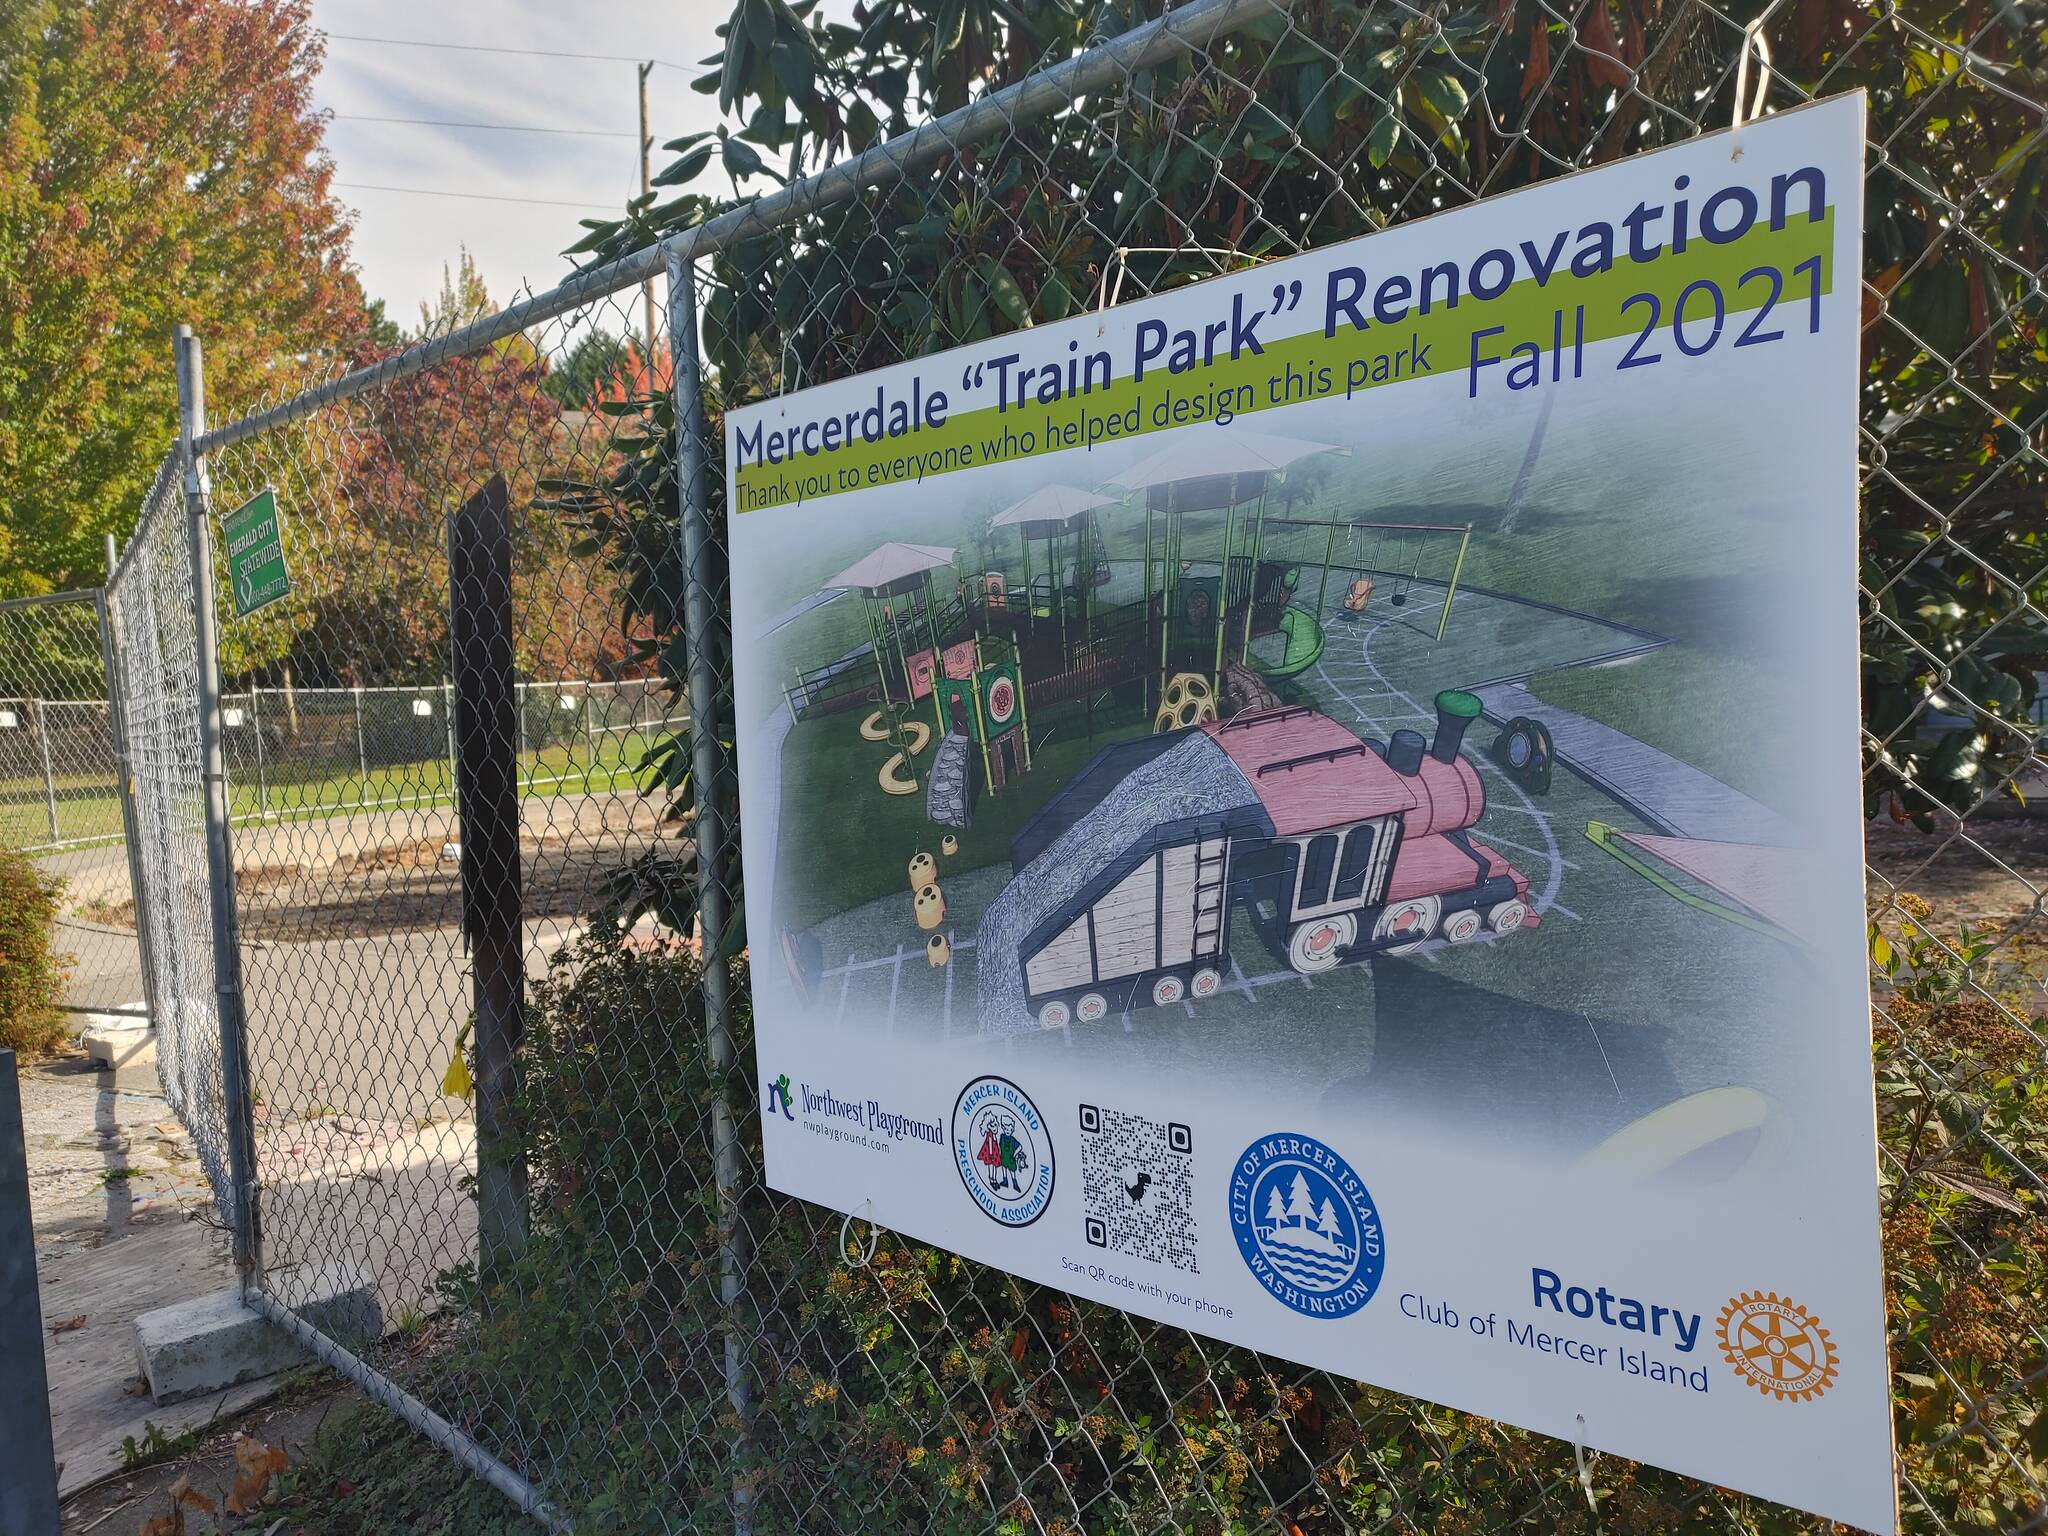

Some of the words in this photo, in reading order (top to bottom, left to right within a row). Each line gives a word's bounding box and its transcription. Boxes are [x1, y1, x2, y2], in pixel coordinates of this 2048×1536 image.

[736, 376, 948, 472] Mercerdale
[1325, 166, 1828, 338] Renovation
[1469, 305, 1584, 399] Fall
[1616, 255, 1824, 372] 2021
[736, 472, 790, 512] Thank
[795, 473, 834, 507] you
[838, 465, 860, 489] to
[868, 443, 973, 485] everyone
[979, 425, 1036, 461] who
[1045, 396, 1141, 452] helped
[1151, 373, 1255, 427] design
[1269, 358, 1332, 404] this
[1346, 333, 1432, 401] park
[230, 528, 258, 559] EMERALD
[258, 517, 274, 539] CITY
[240, 540, 280, 579] STATEWIDE
[800, 1083, 865, 1127] Northwest
[867, 1100, 945, 1146] Playground
[803, 1120, 890, 1153] nwplayground.com
[963, 1085, 1000, 1116] MERCER
[1003, 1087, 1039, 1131] ISLAND
[958, 1139, 998, 1216] PRESCHOOL
[1001, 1164, 1050, 1221] ASSOCIATION
[1234, 1175, 1249, 1225] CITY
[1243, 1151, 1261, 1176] OF
[1261, 1139, 1337, 1173] MERCER
[1338, 1169, 1380, 1257] ISLAND
[1061, 1256, 1086, 1275] Scan
[1088, 1265, 1106, 1282] QR
[1108, 1272, 1135, 1290] code
[1137, 1281, 1163, 1298] with
[1165, 1291, 1191, 1307] your
[1195, 1299, 1233, 1319] phone
[1250, 1252, 1369, 1313] WASHINGTON
[1531, 1267, 1701, 1353] Rotary
[1749, 1303, 1799, 1320] ROTARY
[1400, 1293, 1459, 1329] Club
[1469, 1308, 1497, 1337] of
[1508, 1319, 1607, 1366] Mercer
[1620, 1346, 1708, 1394] Island
[1736, 1354, 1821, 1390] INTERNATIONAL
